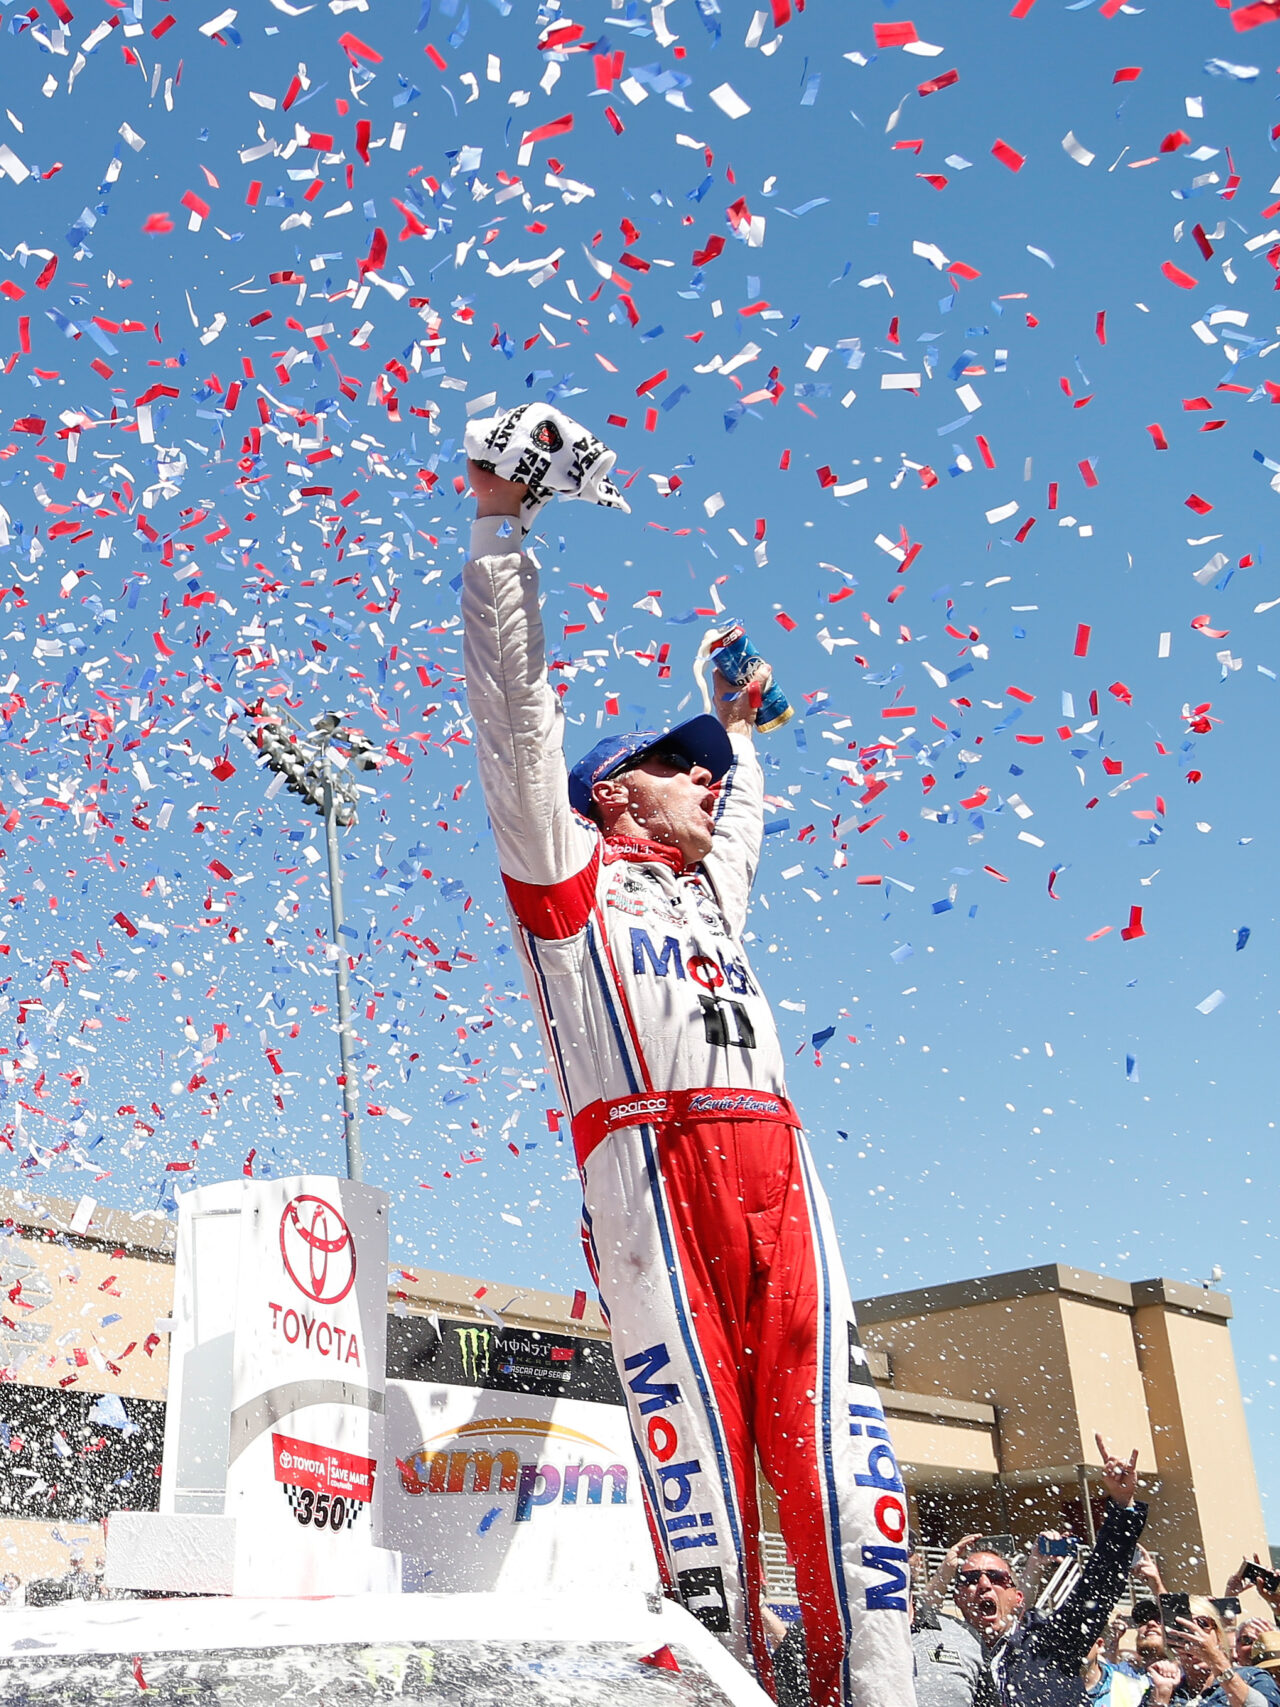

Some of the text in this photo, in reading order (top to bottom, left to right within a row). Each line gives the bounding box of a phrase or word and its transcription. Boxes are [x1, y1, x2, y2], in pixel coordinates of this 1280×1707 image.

[609, 1098, 668, 1120] sparco
[687, 1094, 733, 1112] Kevin
[268, 1302, 361, 1368] TOYOTA
[494, 1336, 558, 1358] MONST
[510, 1365, 533, 1375] ASCAR
[533, 1368, 548, 1376] CUP
[516, 1356, 561, 1367] NERGY
[623, 1343, 719, 1551] Mobil
[292, 1455, 326, 1476] TOYOTA
[330, 1466, 369, 1487] SAVE MART
[296, 1489, 346, 1532] 350
[847, 1403, 910, 1612] Mobil
